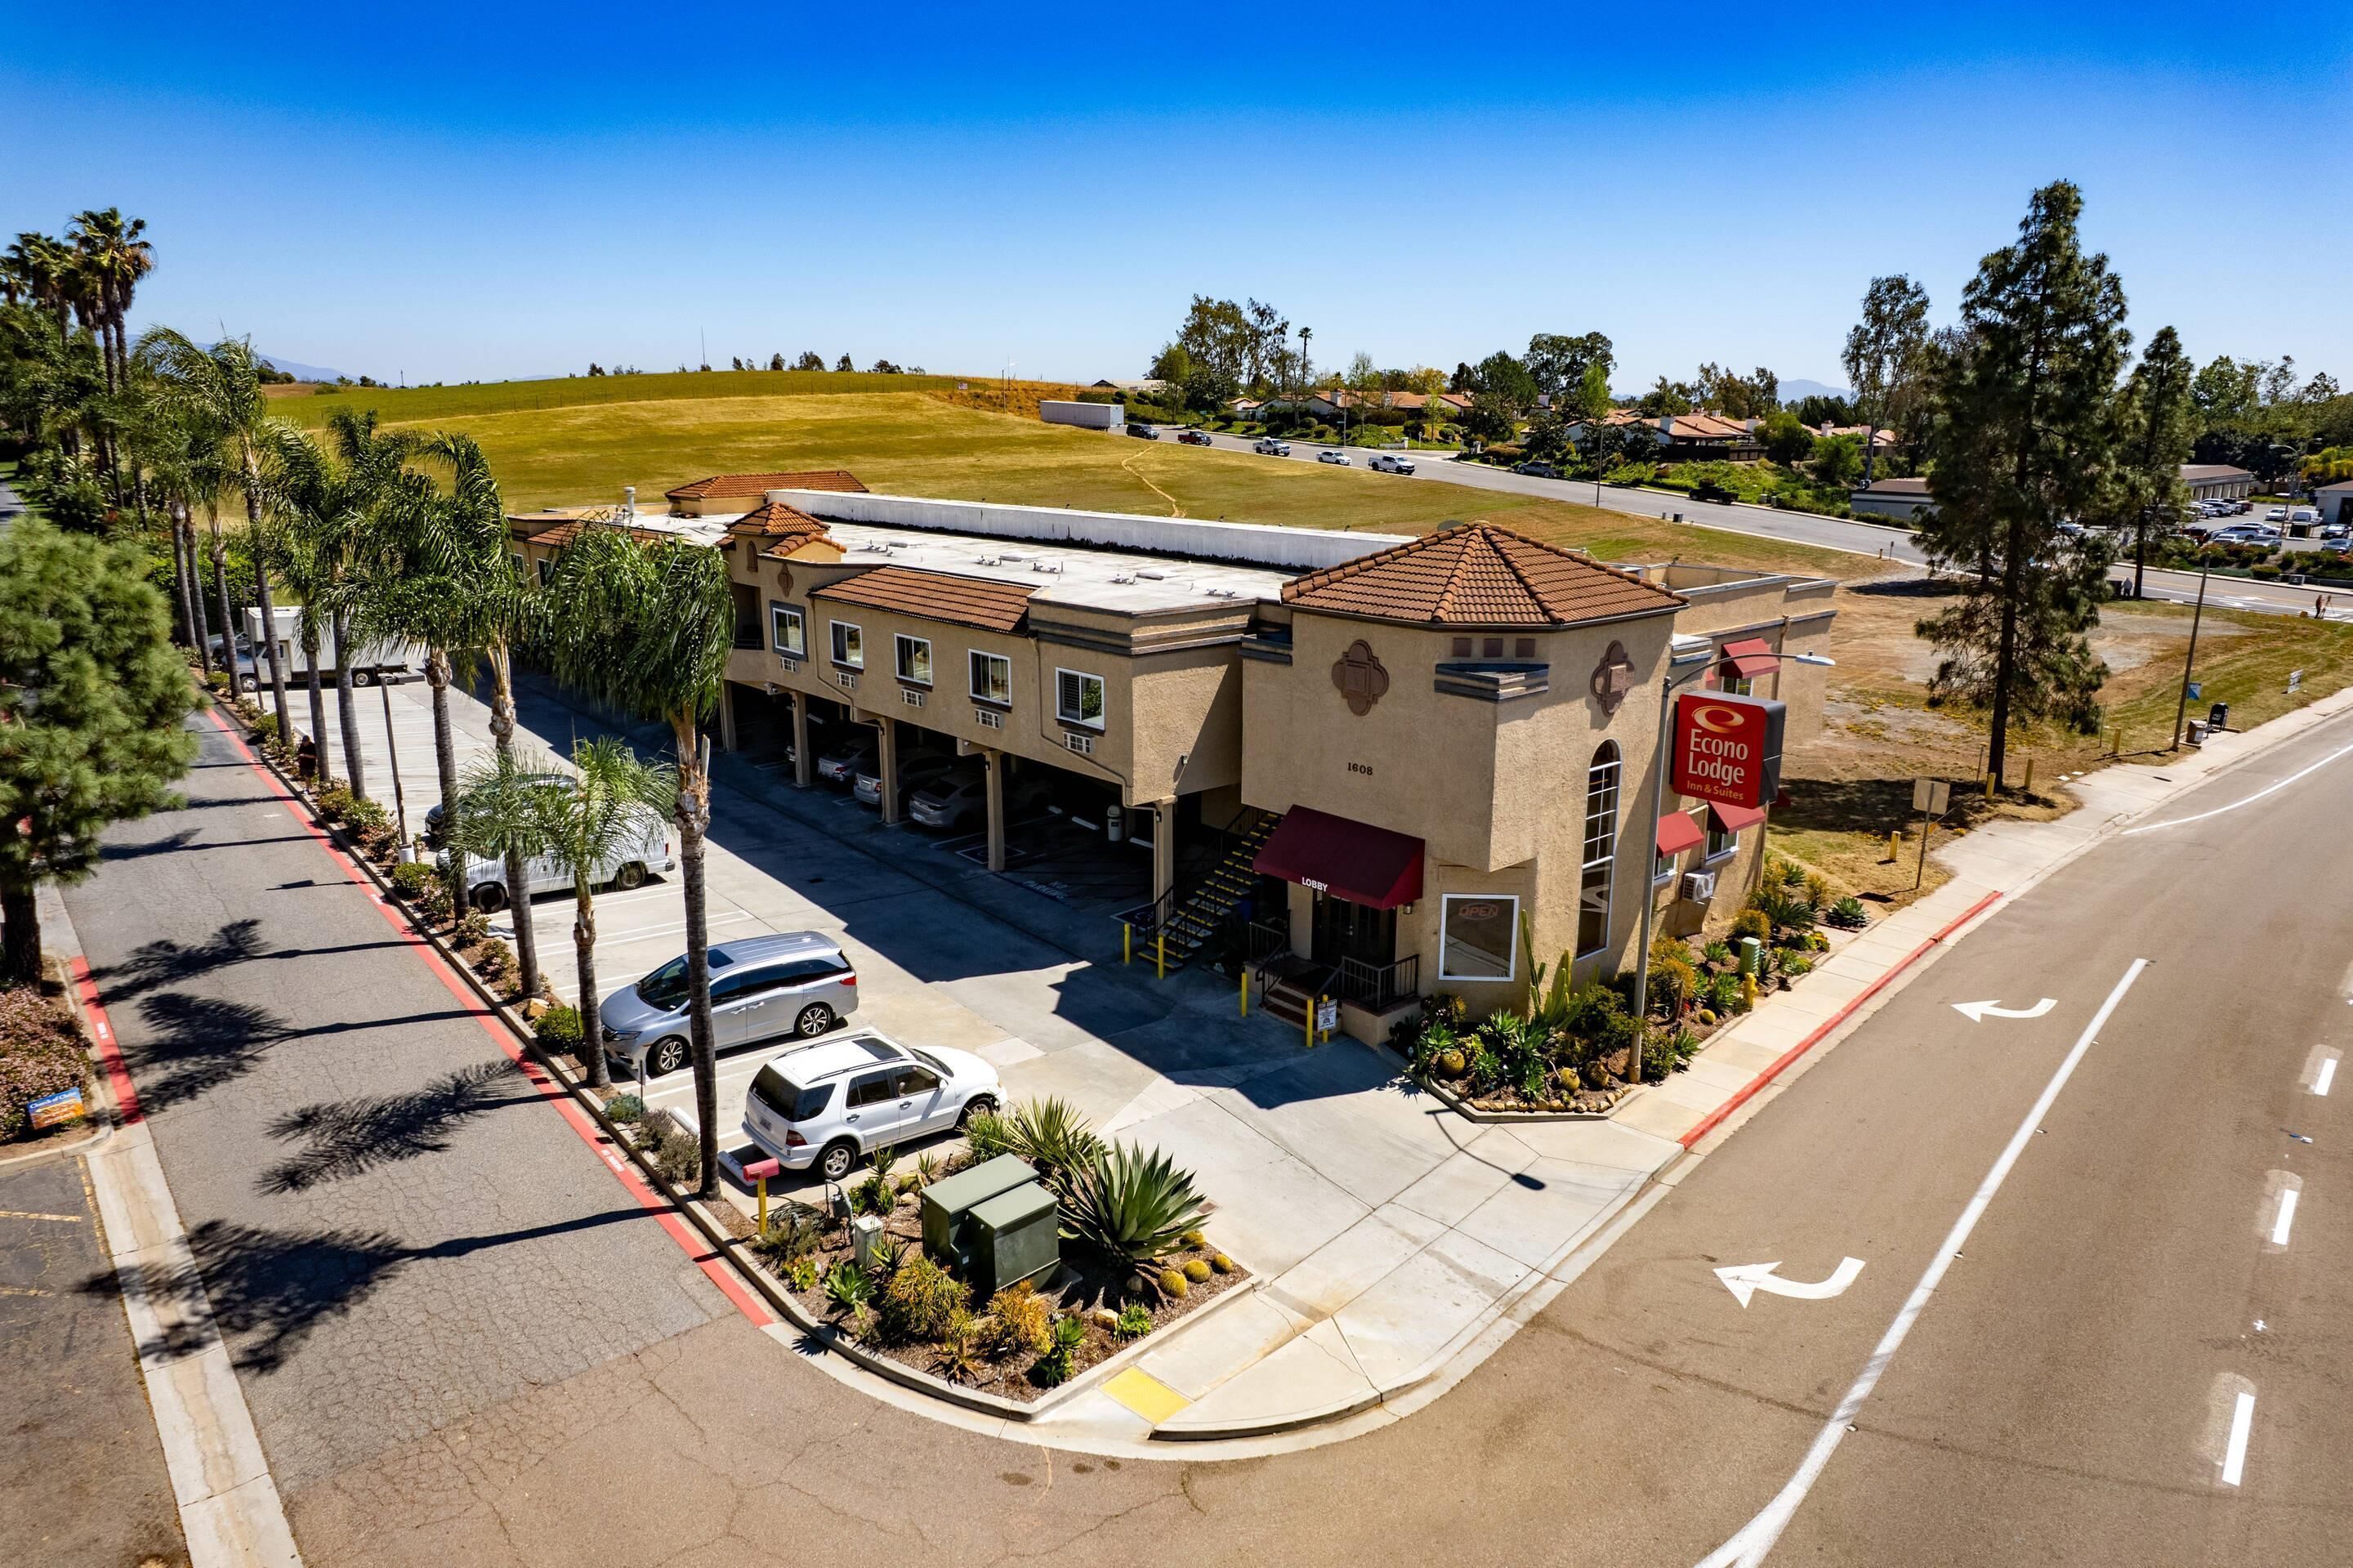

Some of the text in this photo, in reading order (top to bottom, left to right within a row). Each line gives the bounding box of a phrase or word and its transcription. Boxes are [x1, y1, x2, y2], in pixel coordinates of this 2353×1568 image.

[1690, 728, 1748, 760] Econo
[1347, 762, 1373, 775] 1608
[1688, 751, 1745, 787] Lodge
[1686, 780, 1744, 801] Inn & Suites
[1302, 876, 1328, 892] LOBBY
[1458, 906, 1499, 917] OPEN
